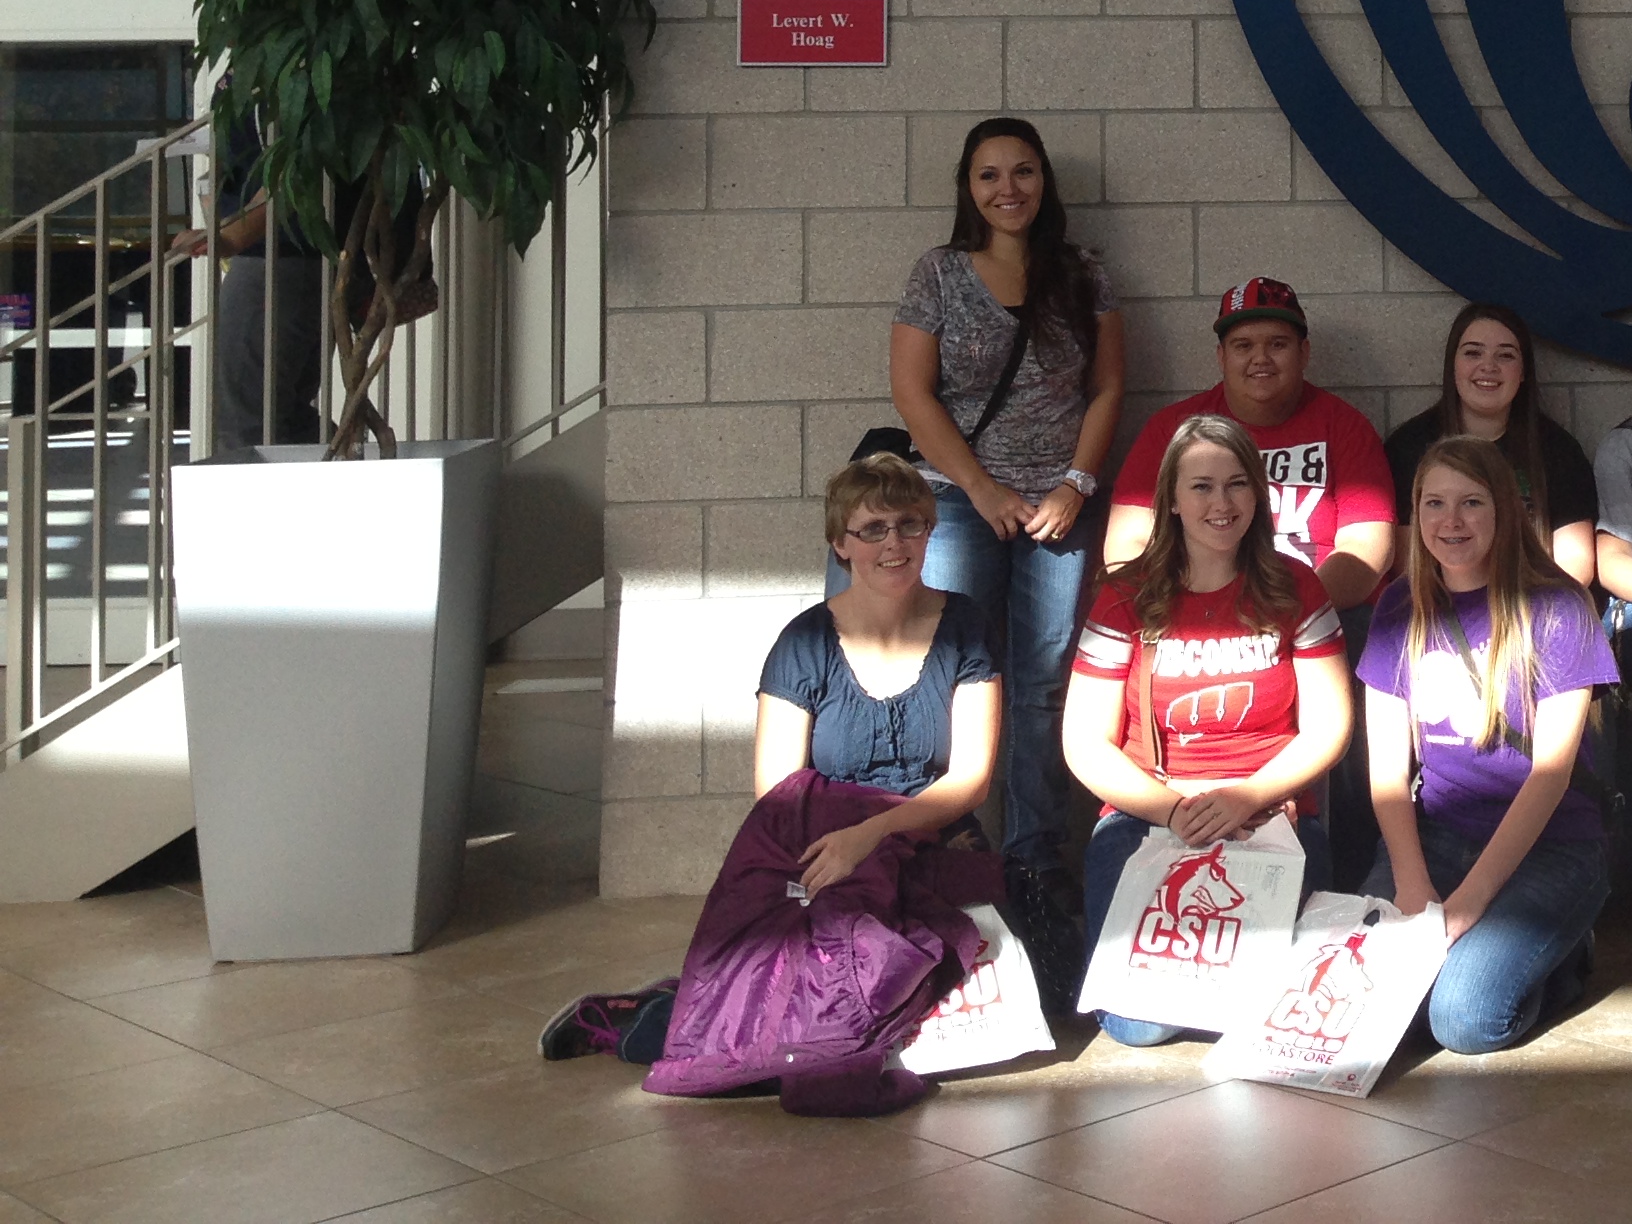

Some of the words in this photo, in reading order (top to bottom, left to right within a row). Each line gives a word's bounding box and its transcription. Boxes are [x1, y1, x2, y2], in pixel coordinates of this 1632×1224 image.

[773, 14, 823, 28] Levert
[831, 14, 854, 28] W.
[792, 32, 835, 49] Hoag
[1301, 444, 1325, 484] &
[1138, 910, 1238, 965] CSU
[1270, 990, 1366, 1039] CSU
